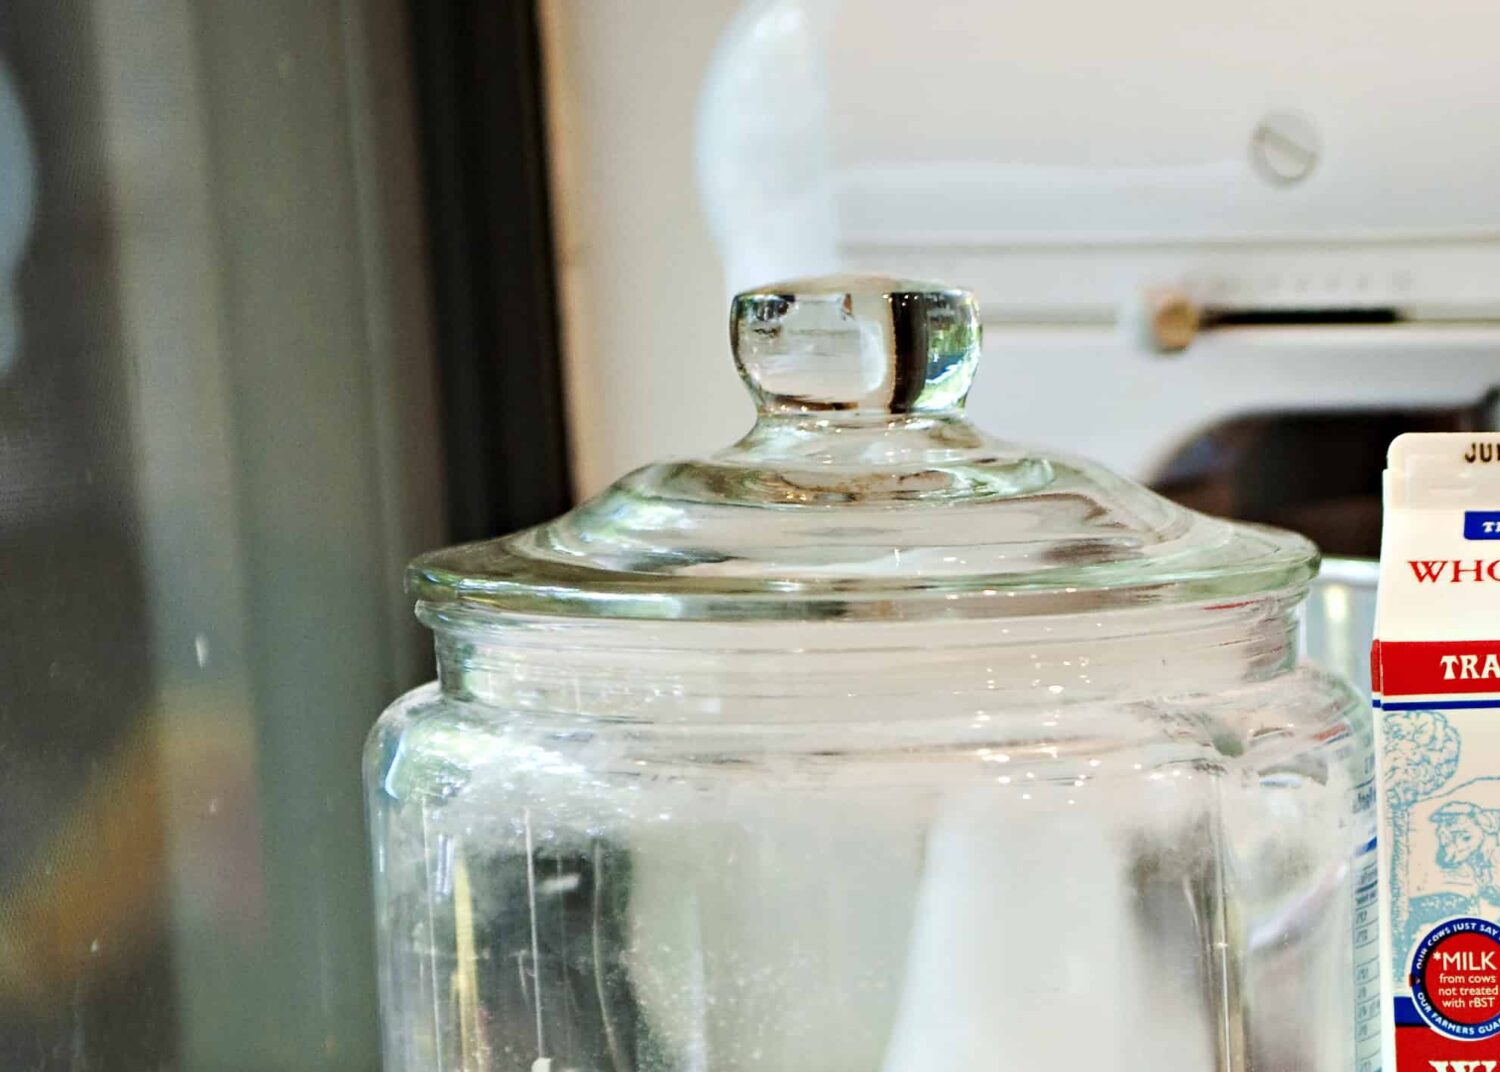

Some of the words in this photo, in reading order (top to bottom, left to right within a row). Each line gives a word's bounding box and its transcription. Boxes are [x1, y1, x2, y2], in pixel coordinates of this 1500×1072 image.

[1416, 948, 1428, 970] OUR
[1427, 927, 1451, 947] COWS
[1453, 922, 1477, 932] JUST
[1479, 924, 1500, 937] SAY
[1439, 973, 1465, 983] from
[1468, 975, 1496, 983] cows
[1438, 987, 1457, 996] not
[1460, 985, 1499, 996] treated
[1442, 998, 1466, 1008] with
[1469, 998, 1495, 1008] rBST
[1418, 992, 1432, 1013] OUR
[1431, 1012, 1475, 1035] FARMERS
